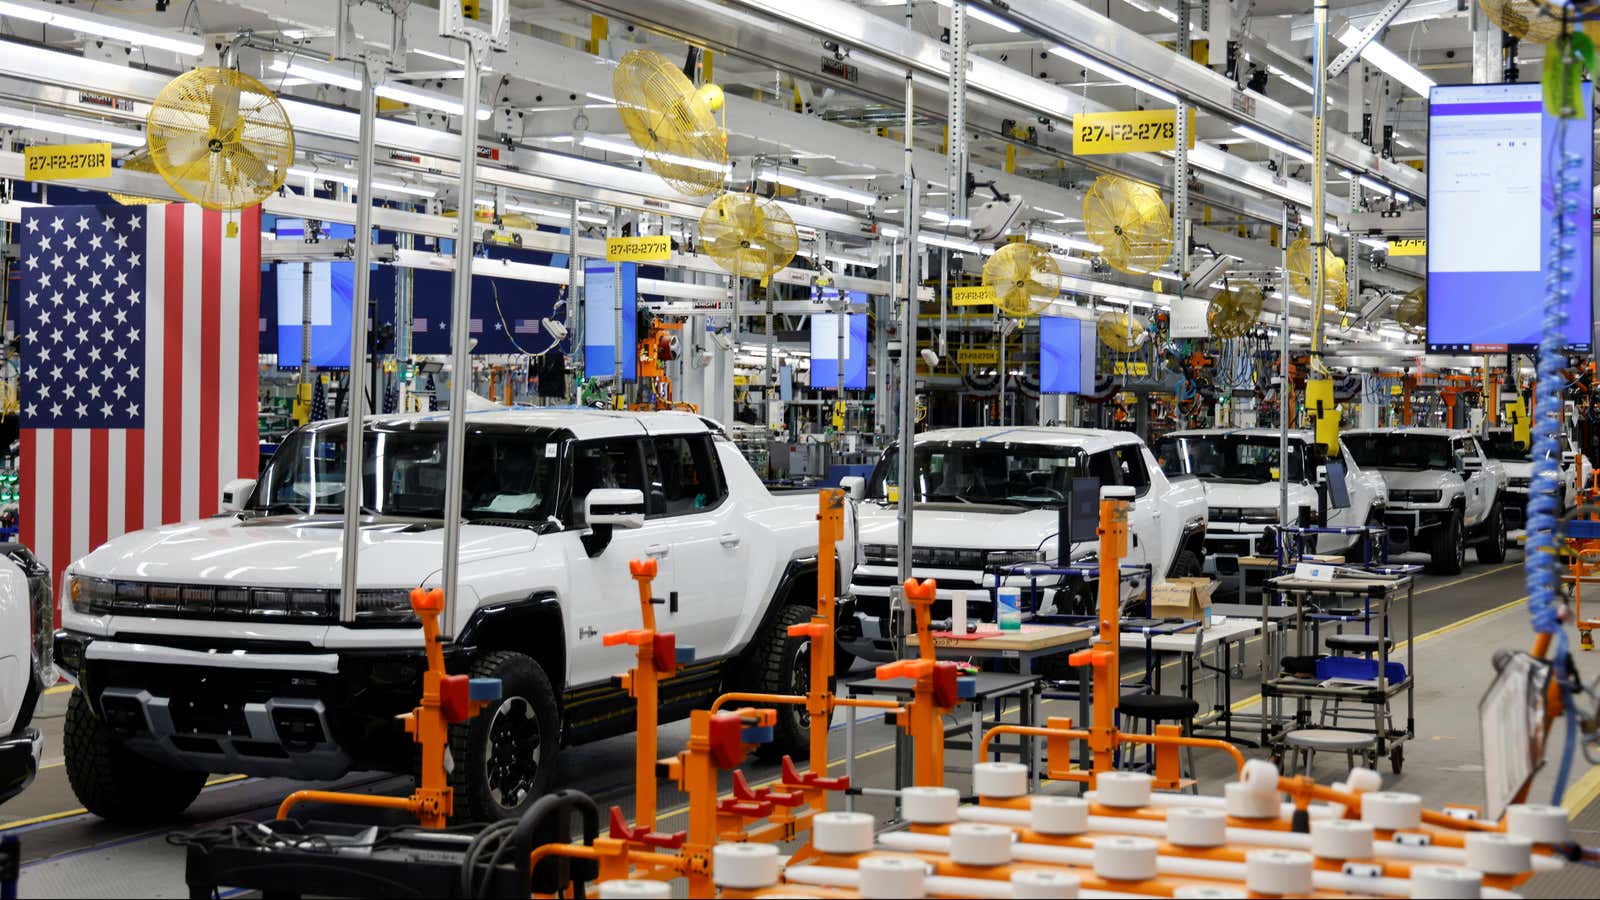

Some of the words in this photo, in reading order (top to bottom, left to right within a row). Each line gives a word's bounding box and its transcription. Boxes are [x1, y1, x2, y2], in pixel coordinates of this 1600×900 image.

[29, 153, 105, 170] 27-F2-278R
[610, 243, 667, 255] 27-F2-277R
[955, 291, 989, 301] 27-F2-27
